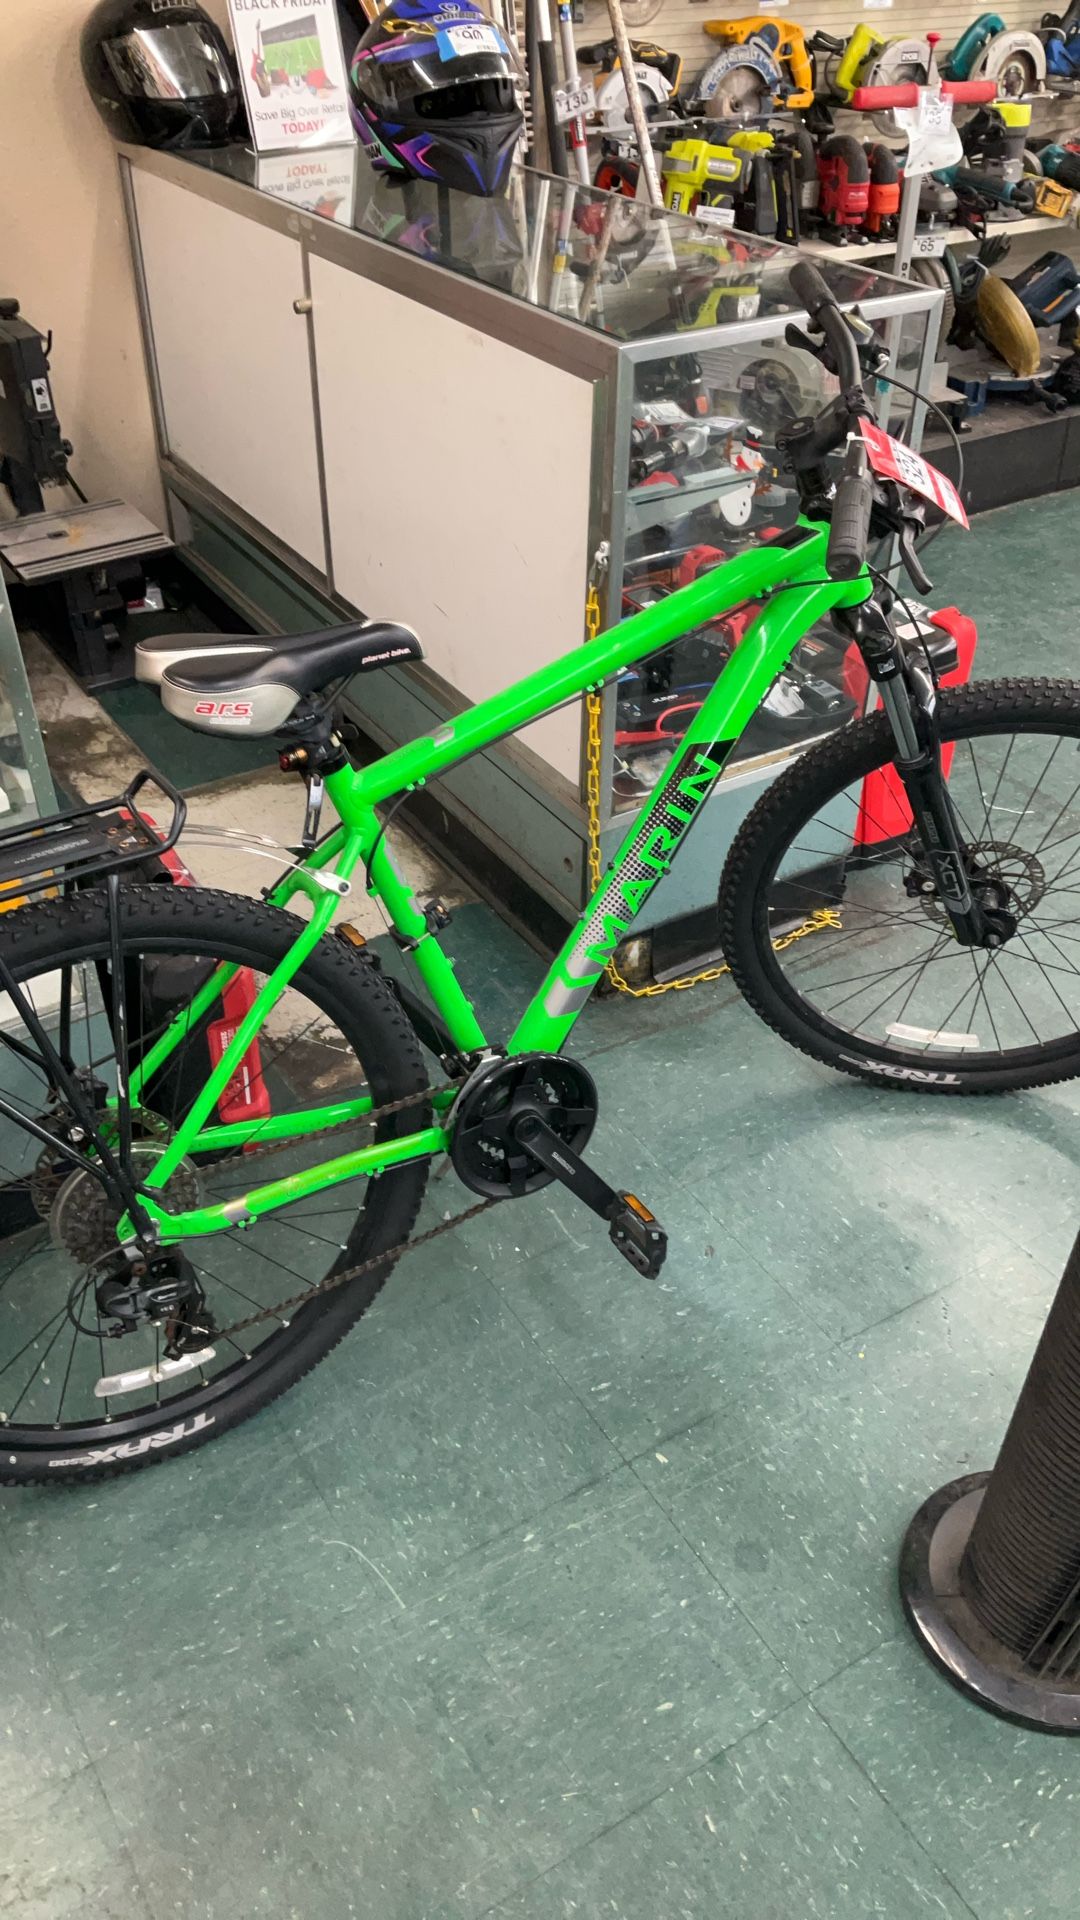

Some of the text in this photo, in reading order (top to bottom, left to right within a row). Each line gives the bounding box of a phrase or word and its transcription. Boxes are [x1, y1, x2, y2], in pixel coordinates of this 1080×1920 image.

[235, 0, 328, 11] BLACK FRIDAY
[255, 111, 279, 121] Save
[280, 107, 296, 121] Big
[297, 106, 320, 117] Over
[584, 753, 722, 966] MARIN
[936, 856, 961, 899] XCT
[860, 1060, 962, 1085] TRAX
[83, 1413, 216, 1467] TRAX
